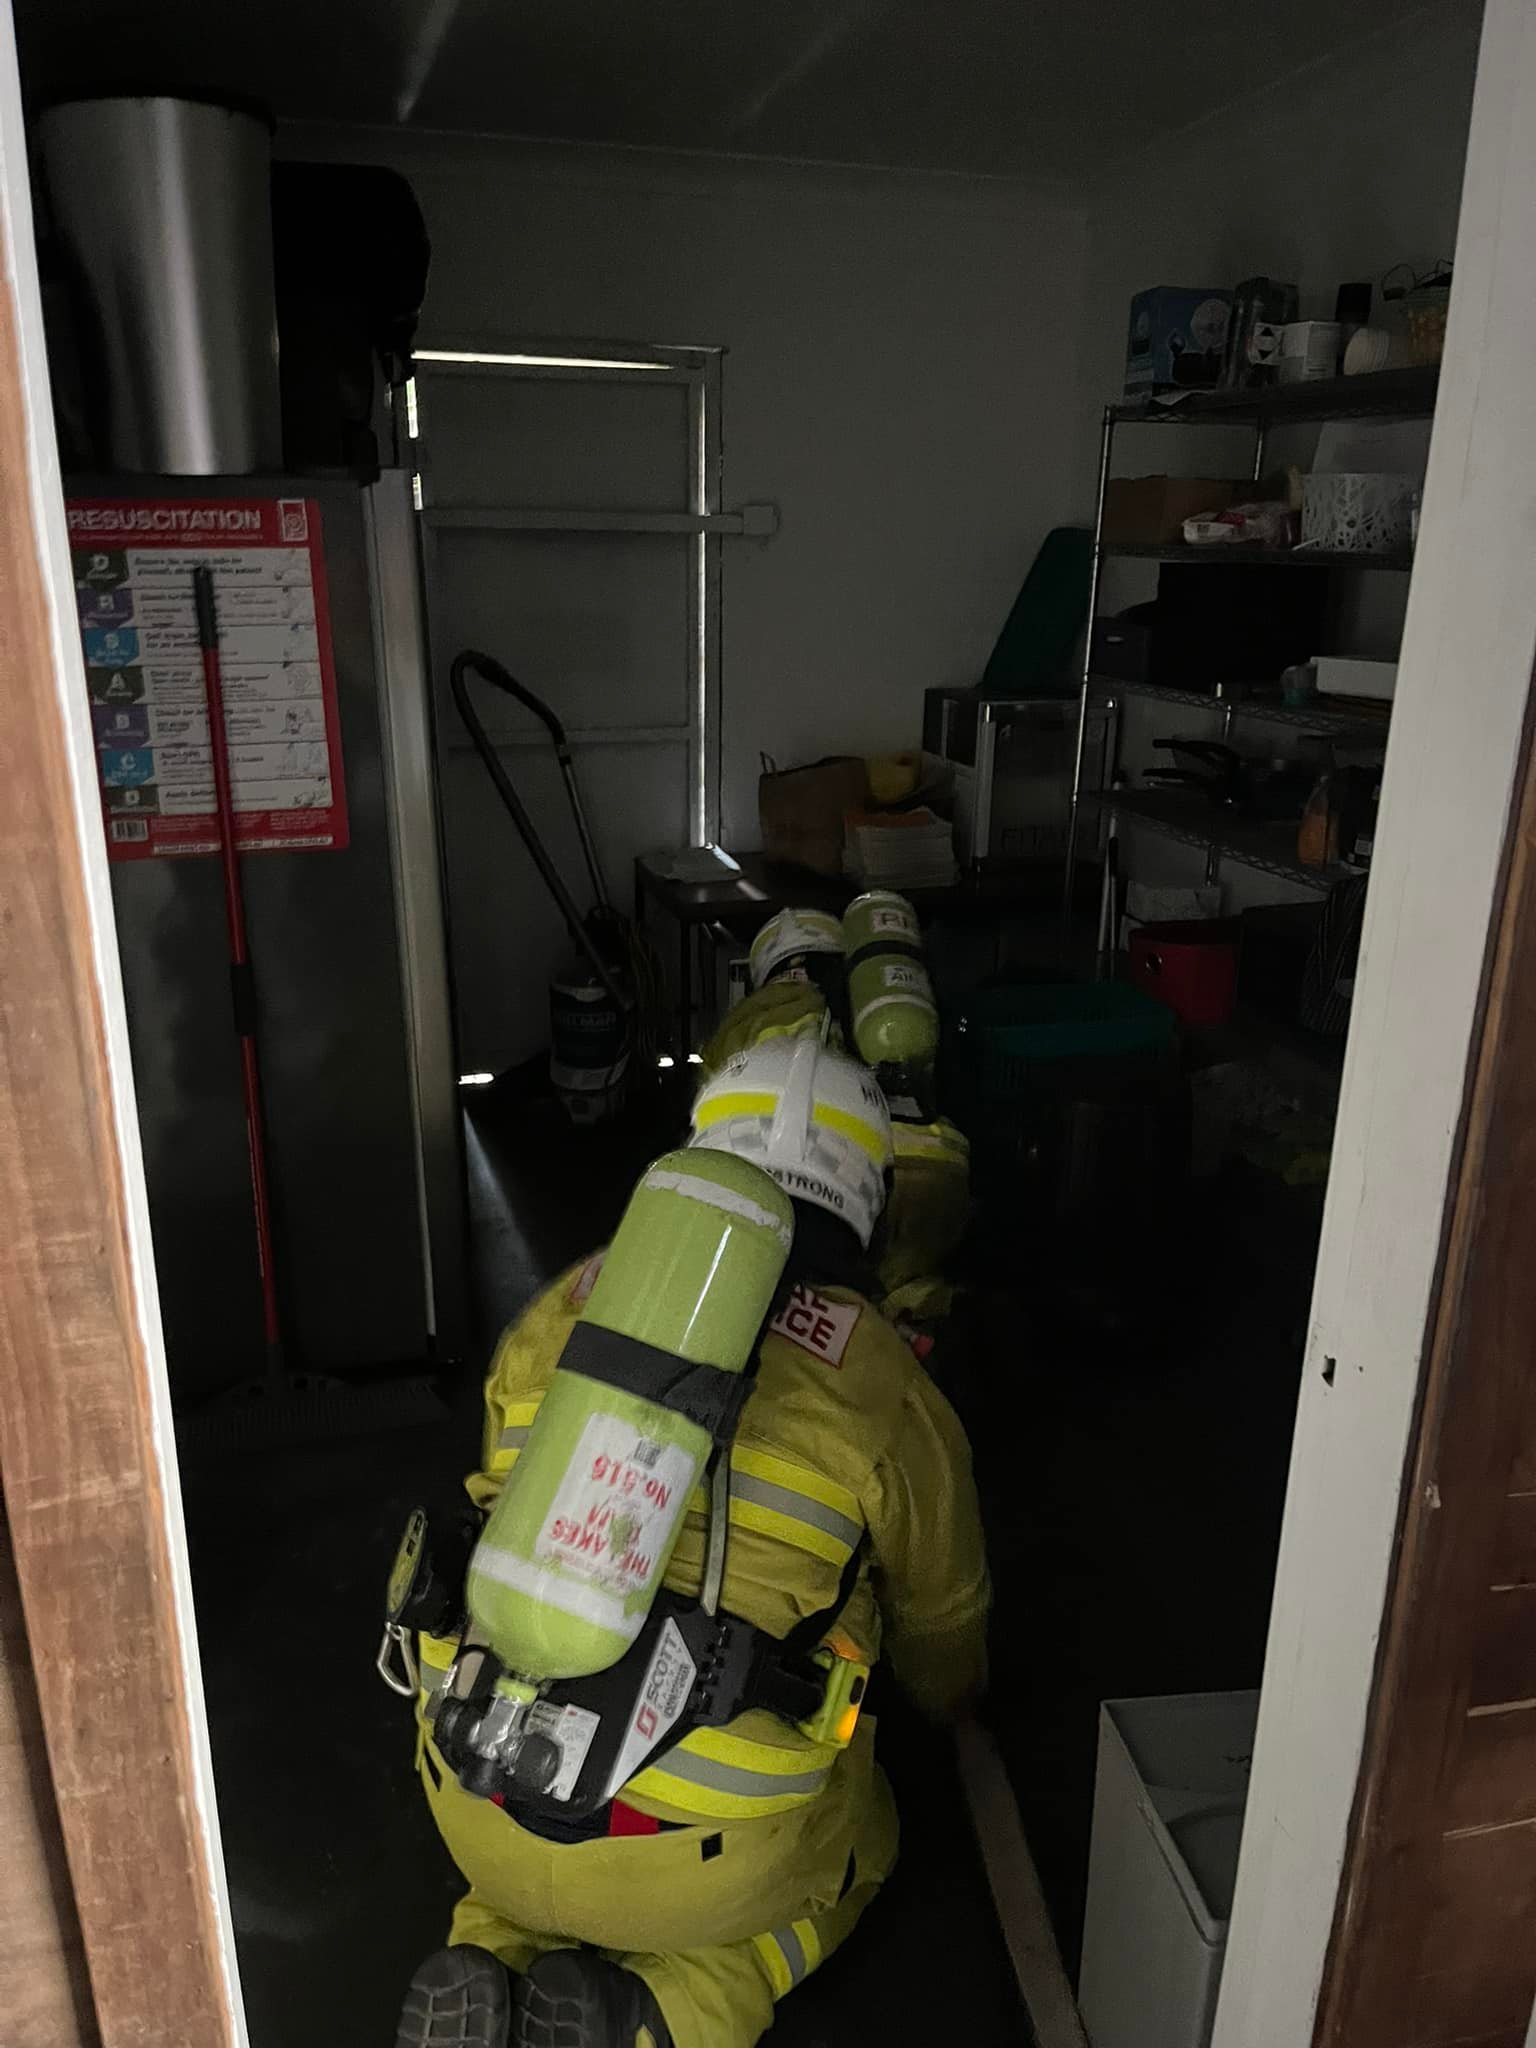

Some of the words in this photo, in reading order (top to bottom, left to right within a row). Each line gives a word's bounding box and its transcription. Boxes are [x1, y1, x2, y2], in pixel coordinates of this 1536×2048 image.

[67, 508, 261, 530] RESUSCITATION
[766, 1168, 844, 1209] STRONG
[646, 1631, 677, 1707] SCOTT
